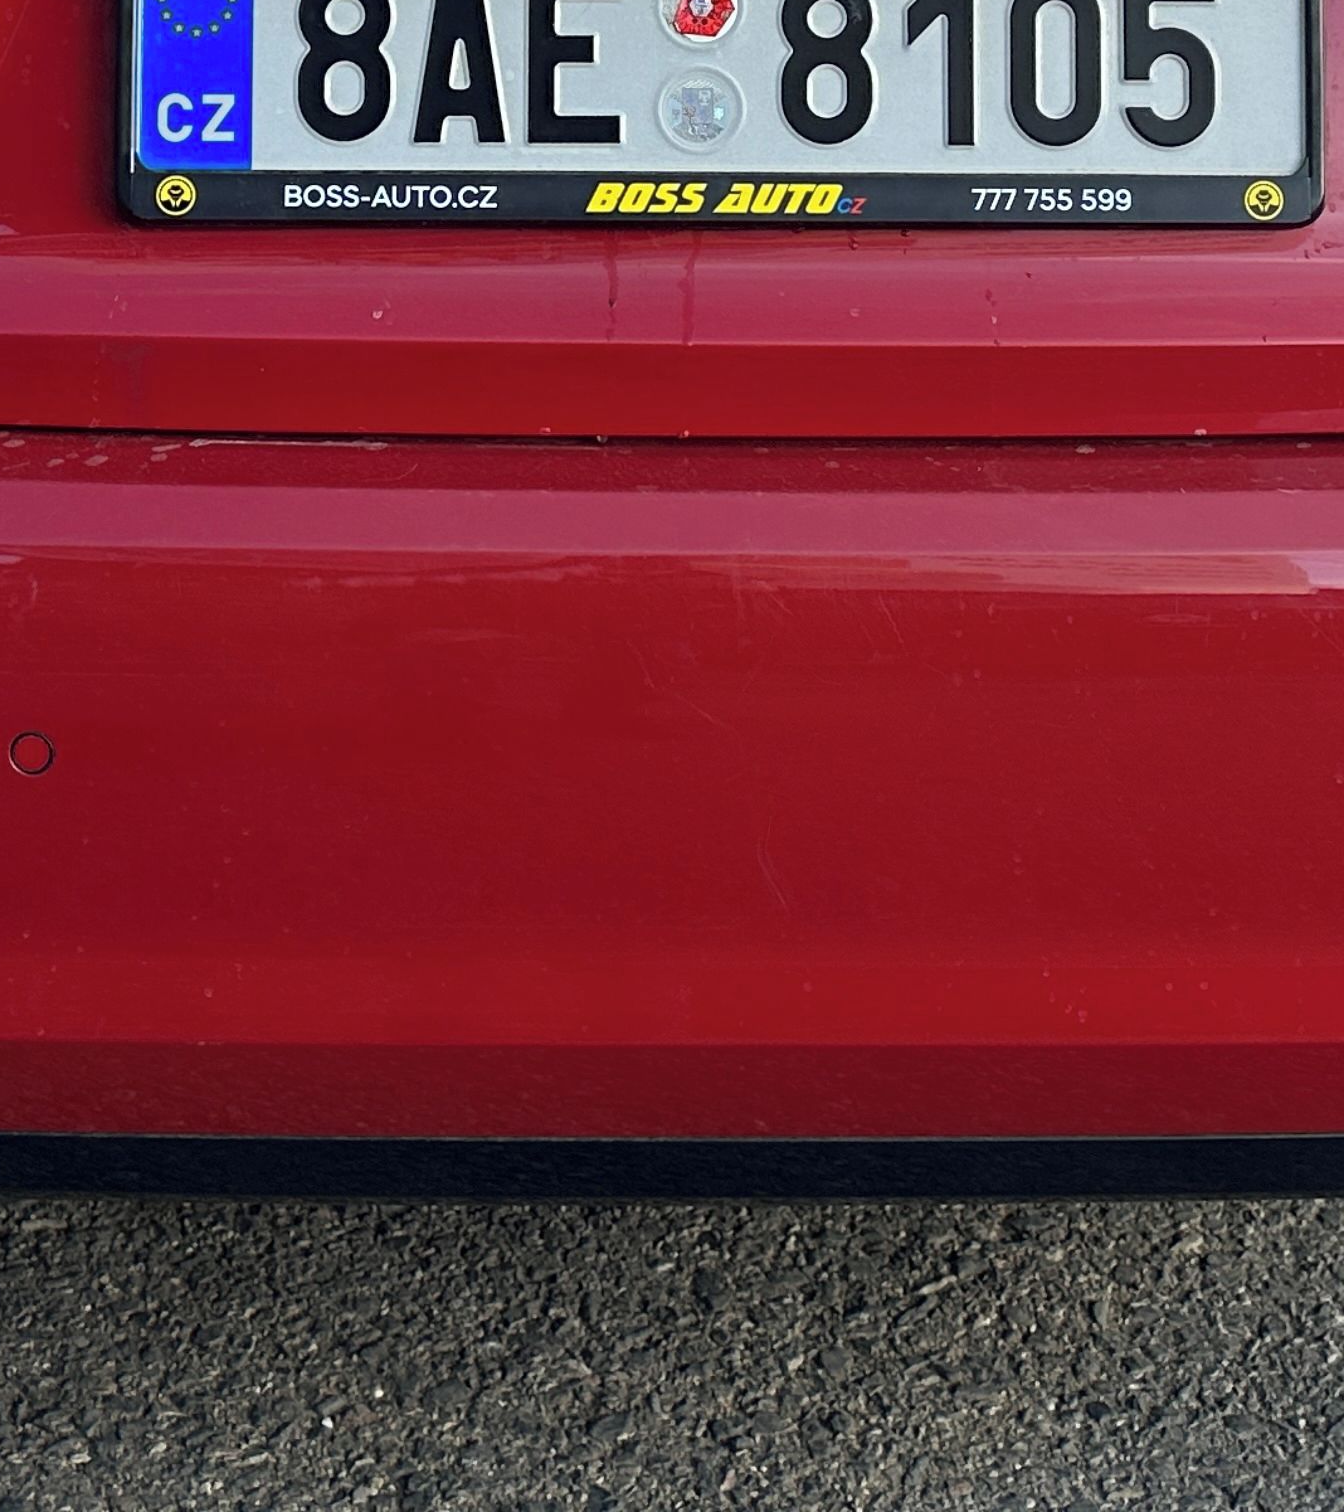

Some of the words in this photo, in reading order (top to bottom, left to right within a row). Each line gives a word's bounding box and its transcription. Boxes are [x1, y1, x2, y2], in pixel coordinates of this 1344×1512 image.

[157, 93, 236, 143] CZ
[283, 183, 498, 210] BOSS-AUTO.CZ
[584, 182, 708, 214] BOSS
[712, 182, 844, 215] AUTO
[971, 188, 1016, 212] 777
[1023, 188, 1077, 212] 755
[1080, 188, 1133, 213] 599
